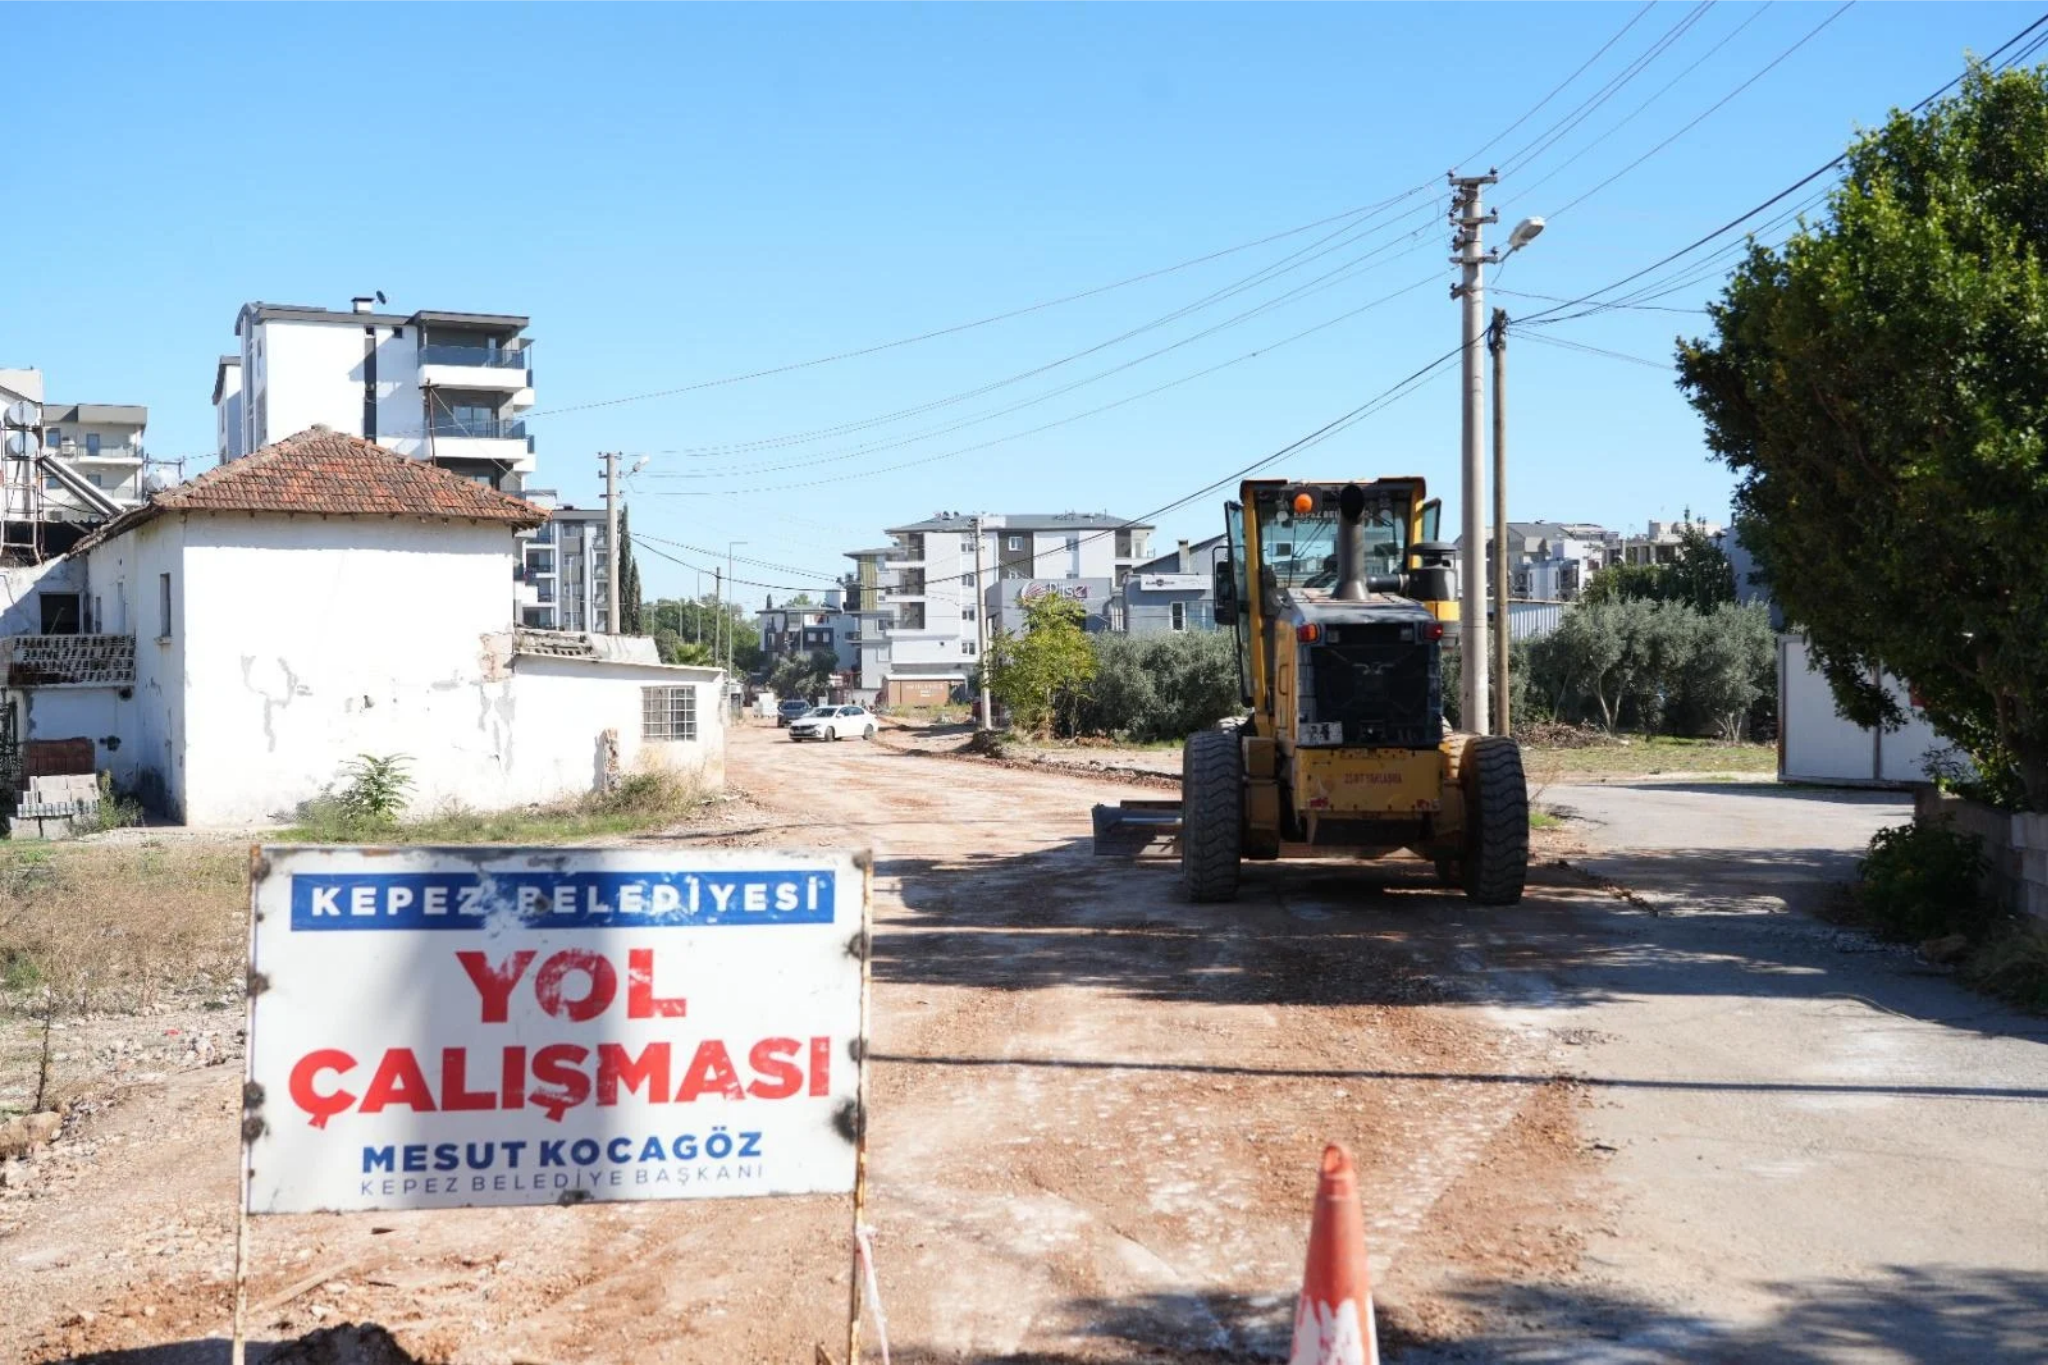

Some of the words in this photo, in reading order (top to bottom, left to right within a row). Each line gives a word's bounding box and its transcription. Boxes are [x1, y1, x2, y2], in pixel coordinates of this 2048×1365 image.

[311, 886, 487, 916] KEPEZ
[517, 876, 818, 914] BELEDİYESİ
[455, 948, 687, 1023] YOL
[288, 1036, 830, 1130] ÇALIŞMASI
[362, 1141, 526, 1173] MESUT
[539, 1126, 762, 1167] KOCAGÖZ
[360, 1177, 458, 1195] KEPEZ
[471, 1170, 622, 1192] BELEDİYE
[635, 1165, 763, 1186] BAŞKANI
